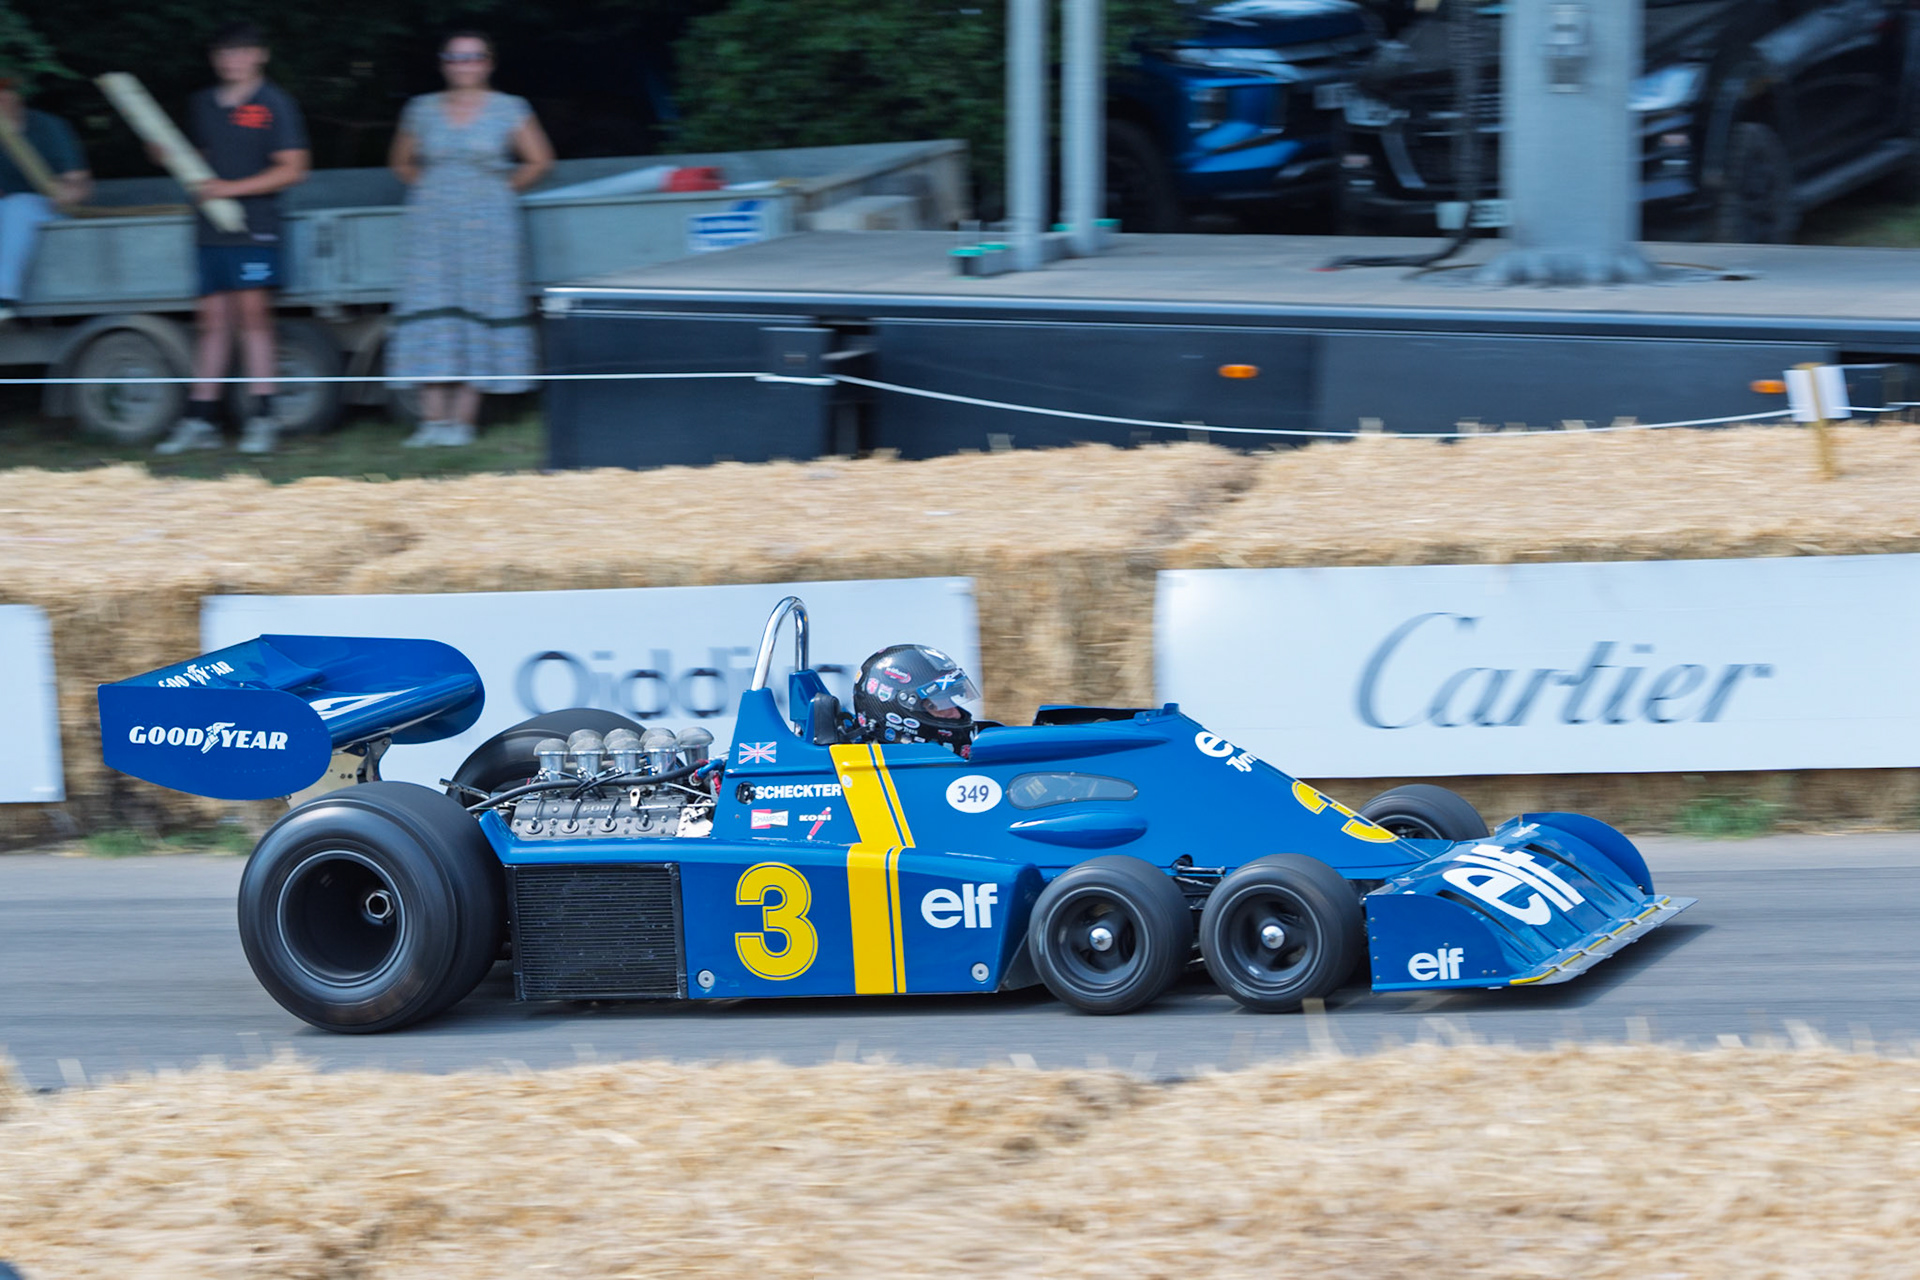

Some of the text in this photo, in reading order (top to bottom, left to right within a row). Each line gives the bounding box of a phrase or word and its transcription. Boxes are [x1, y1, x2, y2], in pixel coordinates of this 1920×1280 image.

[1353, 611, 1776, 729] Cartier
[755, 783, 842, 800] SCHECKTER
[957, 784, 989, 803] 349
[799, 814, 832, 822] KONI
[1442, 843, 1586, 926] elf
[735, 861, 818, 981] 3
[920, 883, 998, 929] elf
[1408, 947, 1464, 981] elf
